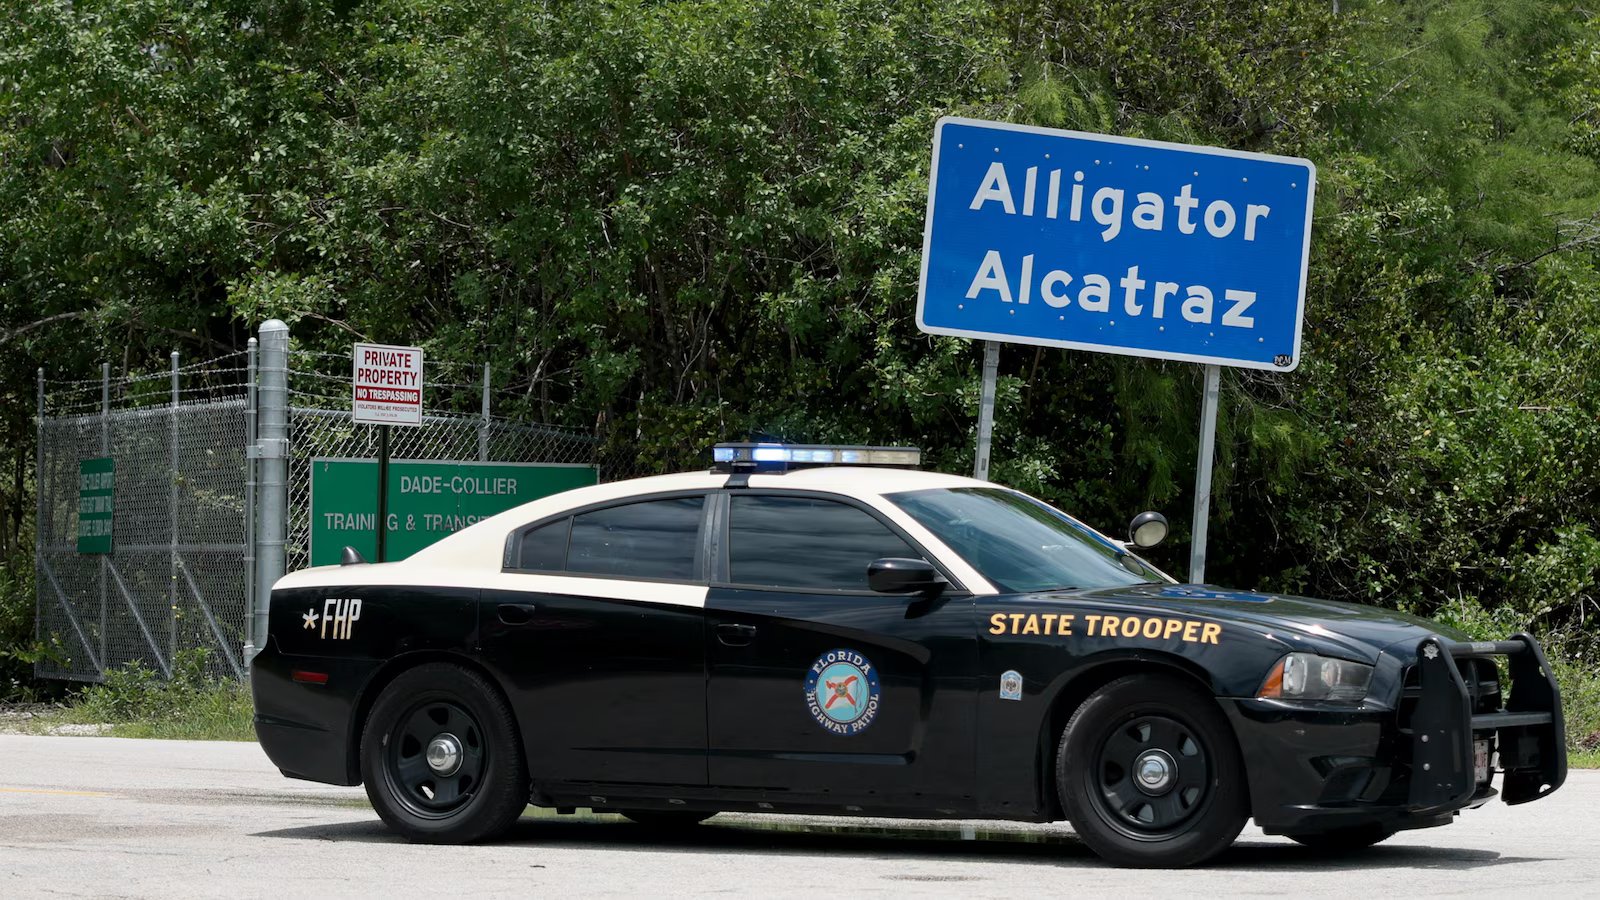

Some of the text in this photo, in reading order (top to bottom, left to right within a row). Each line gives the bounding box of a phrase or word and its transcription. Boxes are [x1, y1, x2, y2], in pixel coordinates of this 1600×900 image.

[969, 162, 1271, 243] Alligator
[965, 249, 1257, 329] Alcatraz
[364, 350, 412, 368] PRIVATE
[357, 368, 418, 386] PROPERTY
[357, 388, 418, 402] NO TRESPASSING
[400, 475, 517, 495] DADE-COLLIER
[324, 512, 491, 532] TRAINIG & TRANS
[988, 613, 1222, 645] STATE TROOPER
[812, 650, 871, 676] FLORIDA
[806, 688, 879, 734] HIGHWAY PATROL
